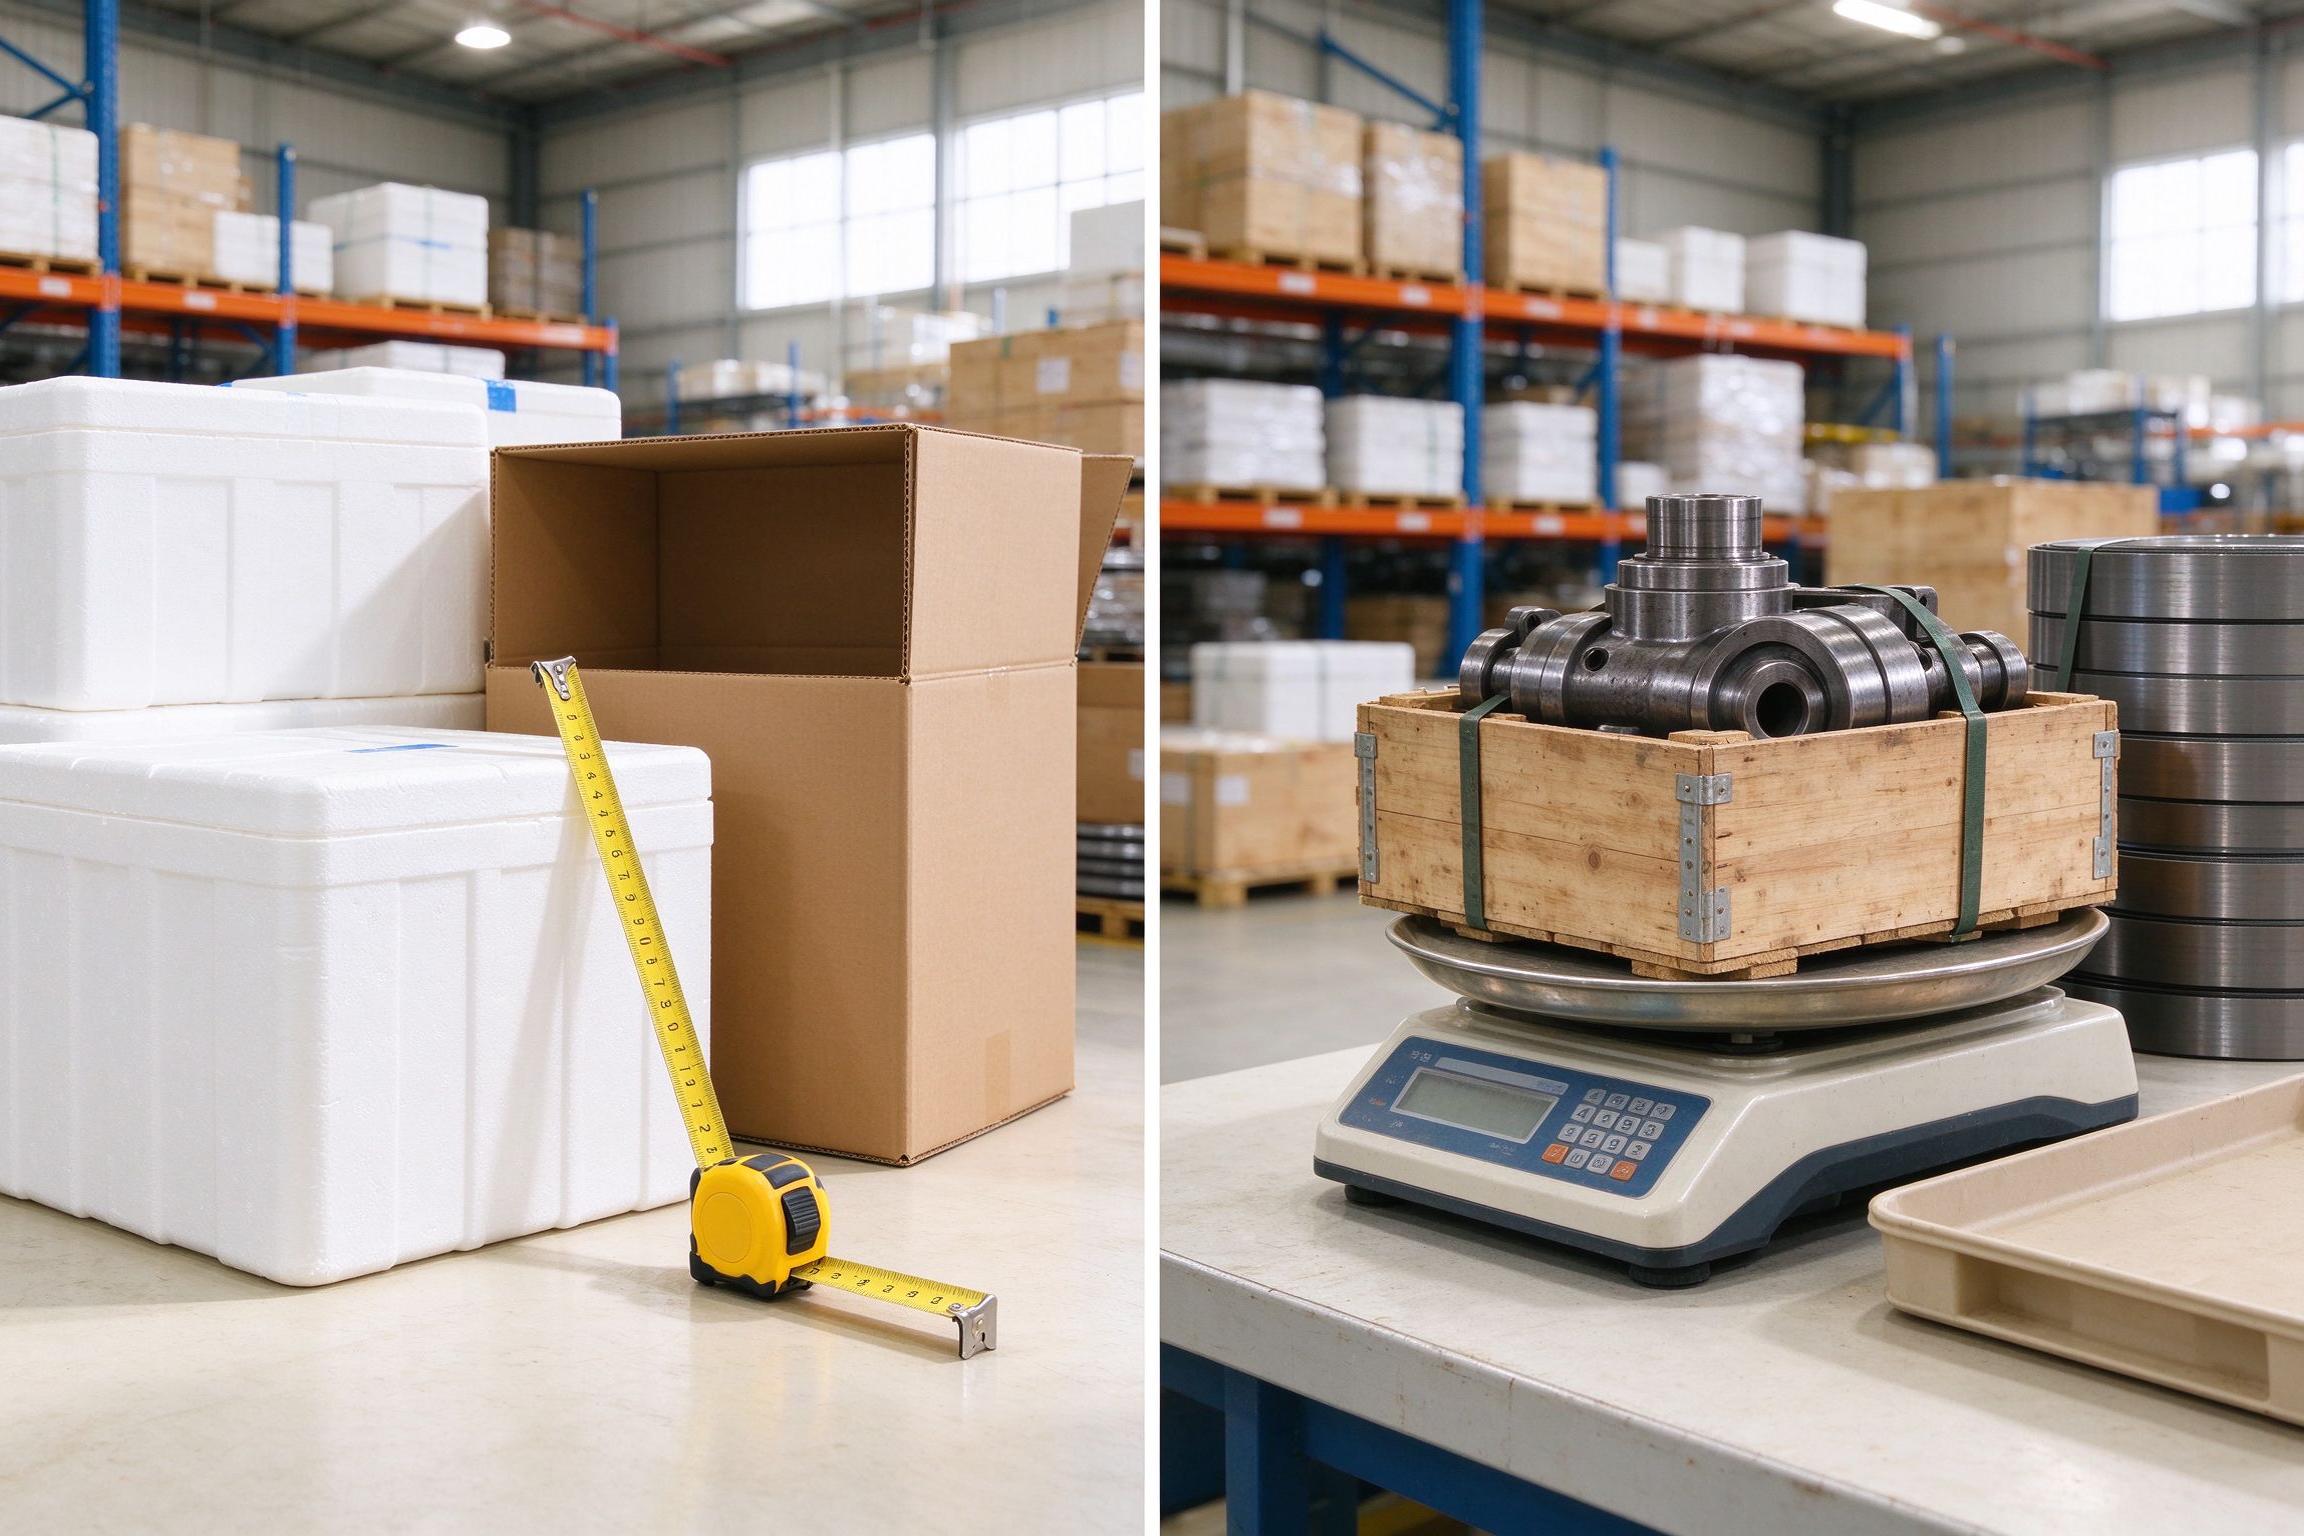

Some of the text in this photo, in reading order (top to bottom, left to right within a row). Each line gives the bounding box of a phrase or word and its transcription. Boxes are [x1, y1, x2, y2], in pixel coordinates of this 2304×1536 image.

[611, 849, 623, 858] 6
[653, 977, 665, 987] 7
[699, 1124, 711, 1133] 2
